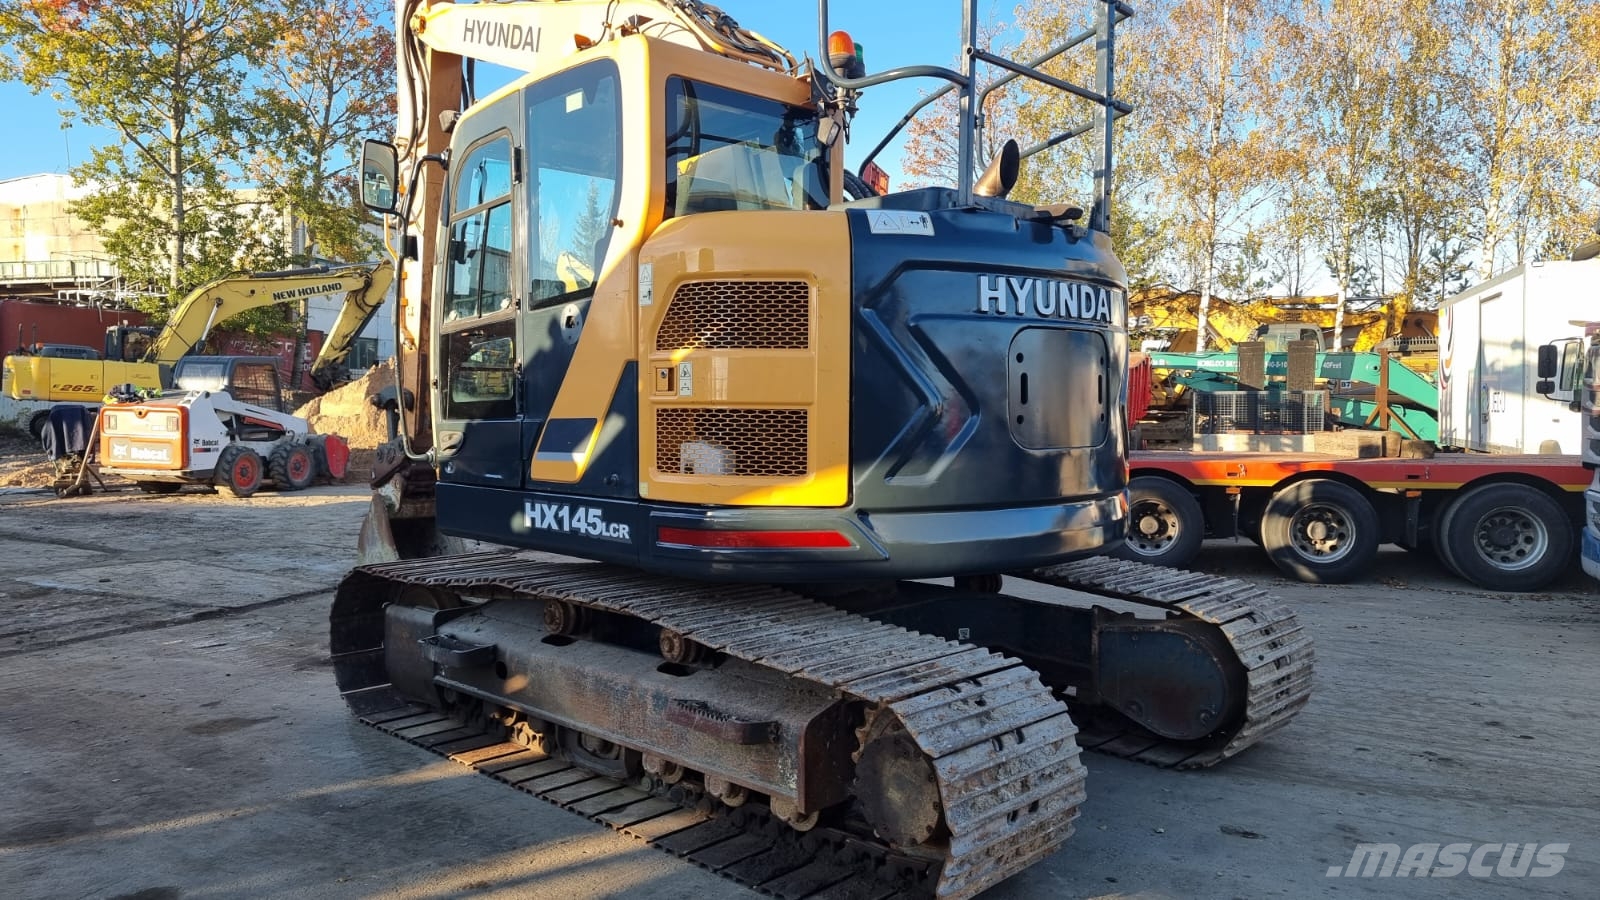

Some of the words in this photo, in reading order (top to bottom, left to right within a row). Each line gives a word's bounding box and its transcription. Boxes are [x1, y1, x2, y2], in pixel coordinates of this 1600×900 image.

[463, 18, 541, 53] HYUNDAI
[273, 289, 296, 300] NEW
[297, 282, 342, 297] HOLLAND
[979, 275, 1114, 325] HYUNDAI
[1128, 316, 1150, 327] SE
[131, 447, 168, 460] Bobcat
